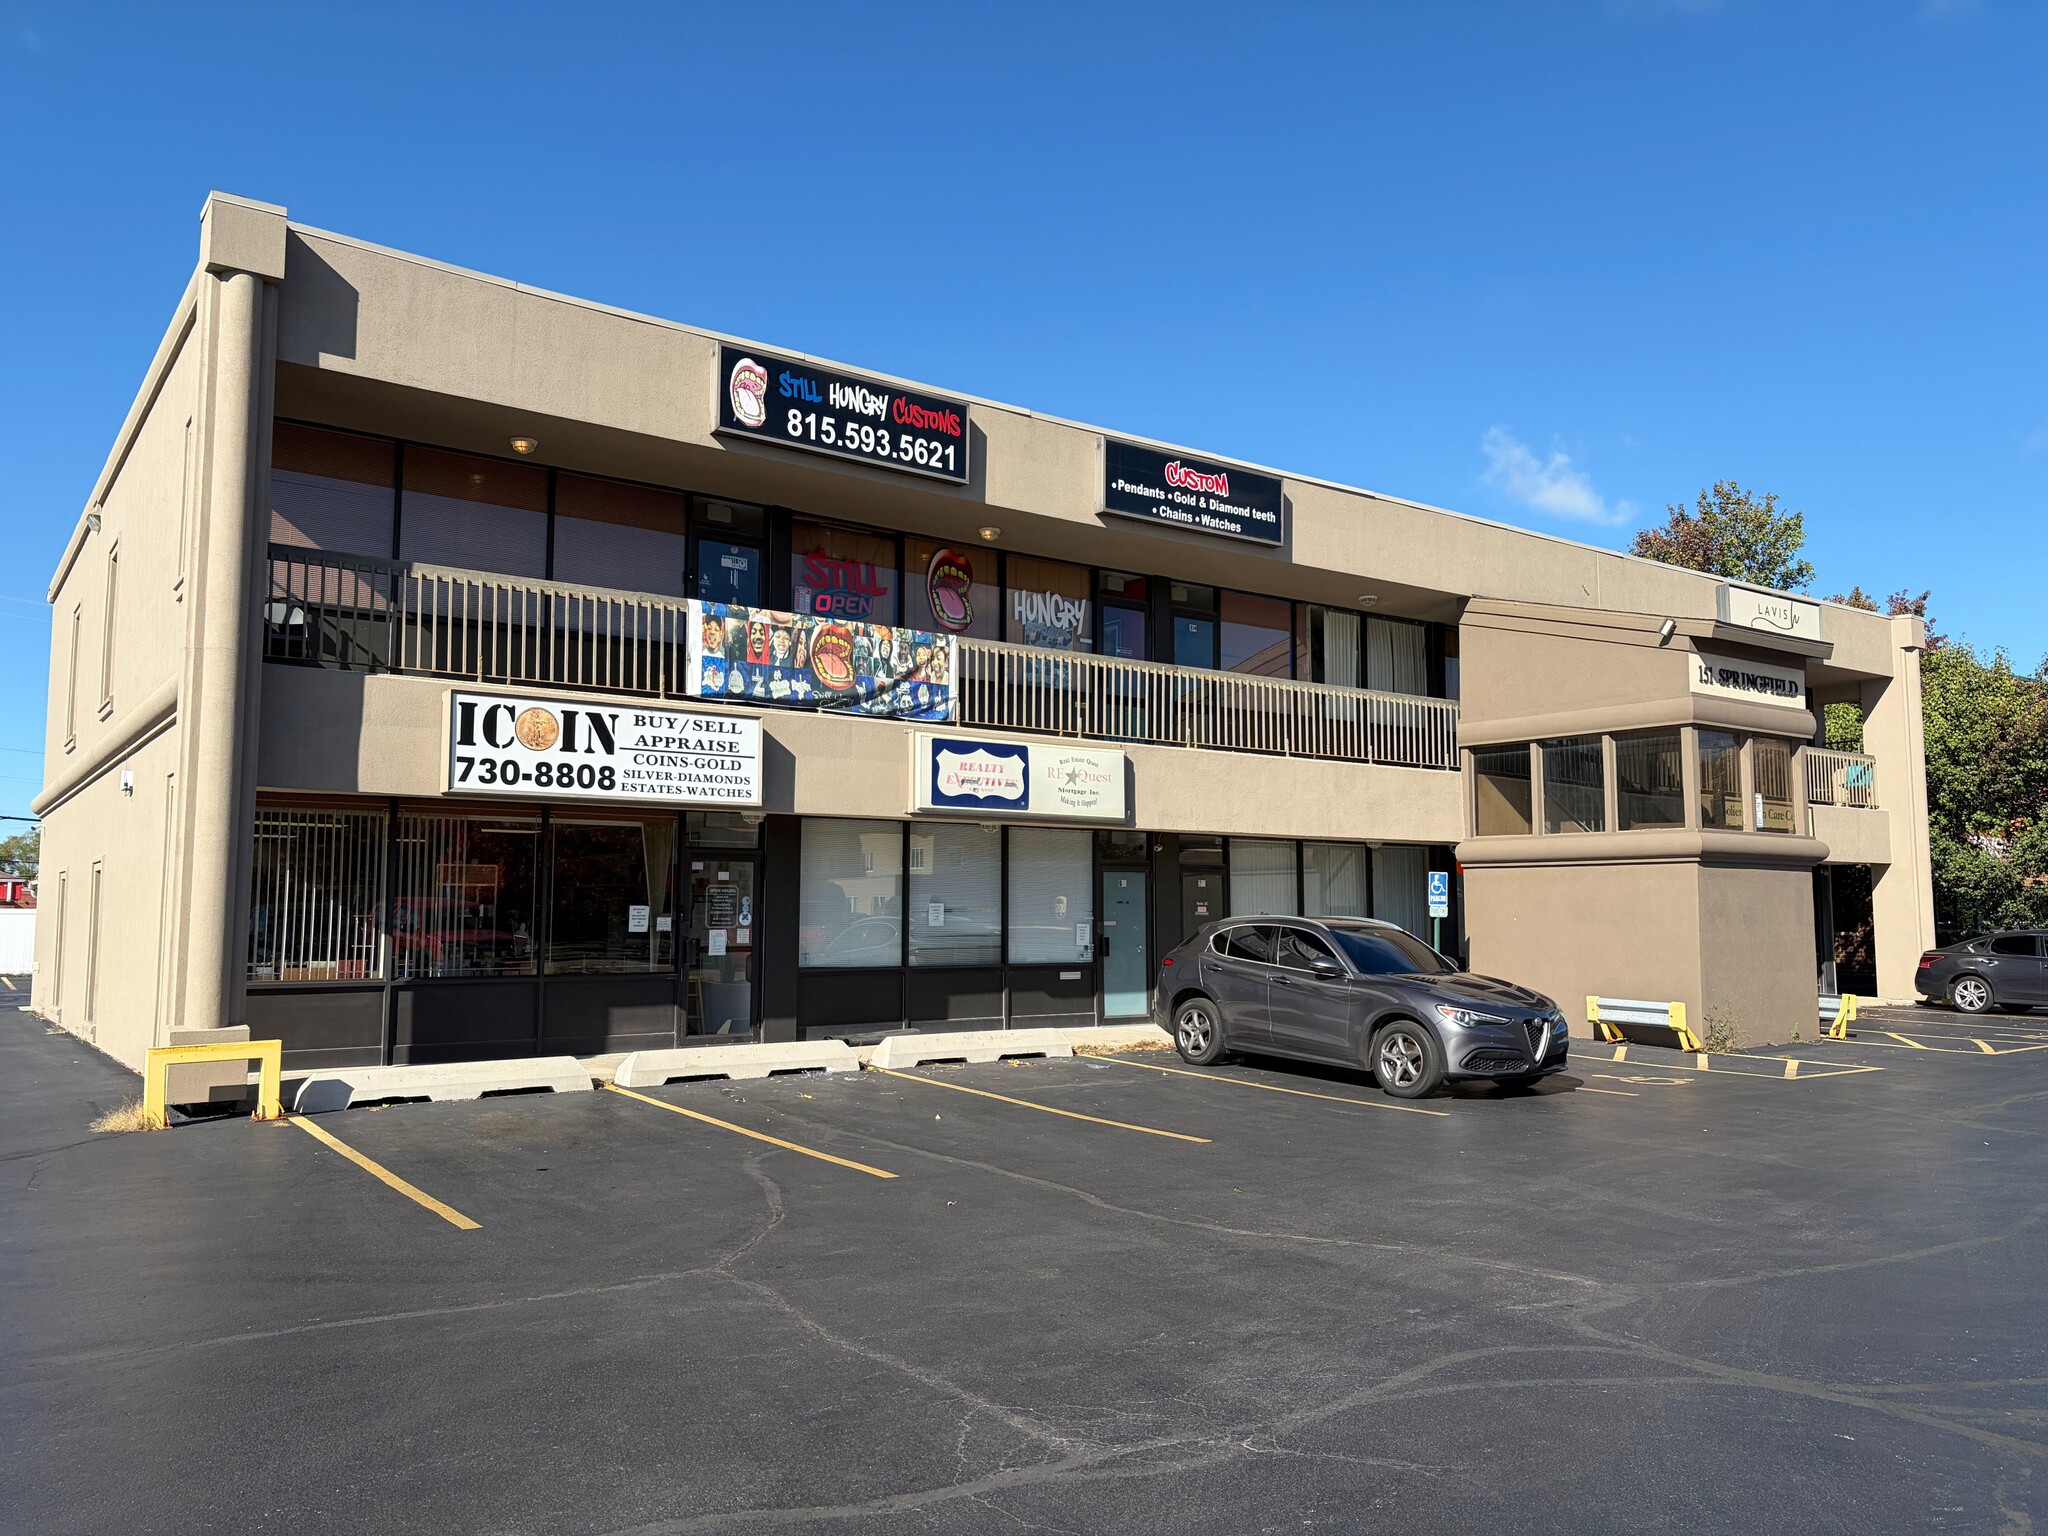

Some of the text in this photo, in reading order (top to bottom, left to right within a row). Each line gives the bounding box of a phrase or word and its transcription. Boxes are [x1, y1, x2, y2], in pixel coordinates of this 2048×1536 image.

[779, 370, 961, 437] STILL HUNGRY CUSTOMS
[787, 408, 955, 471] 815.593.5621
[1165, 460, 1229, 498] CUSTOM
[1118, 479, 1276, 523] Pendants Gold & Diamond teeth
[1160, 506, 1242, 533] Chains Watches
[805, 548, 888, 597] STILL
[815, 595, 874, 615] OPEN
[1014, 589, 1087, 636] HUNGRY
[1698, 665, 1799, 697] 151 SPRINGFIELD
[634, 734, 741, 753] APPRAISE
[633, 753, 742, 772] COINS-GOLD
[959, 762, 1005, 774] REALTY
[1059, 757, 1070, 765] Real
[456, 756, 617, 791] 730-8808
[623, 768, 751, 786] SILVER-DIAMONDS
[1077, 769, 1112, 783] Quest
[620, 782, 753, 799] ESTATES-WATCHES
[1058, 787, 1087, 796] Mortgage
[1768, 808, 1785, 820] Care
